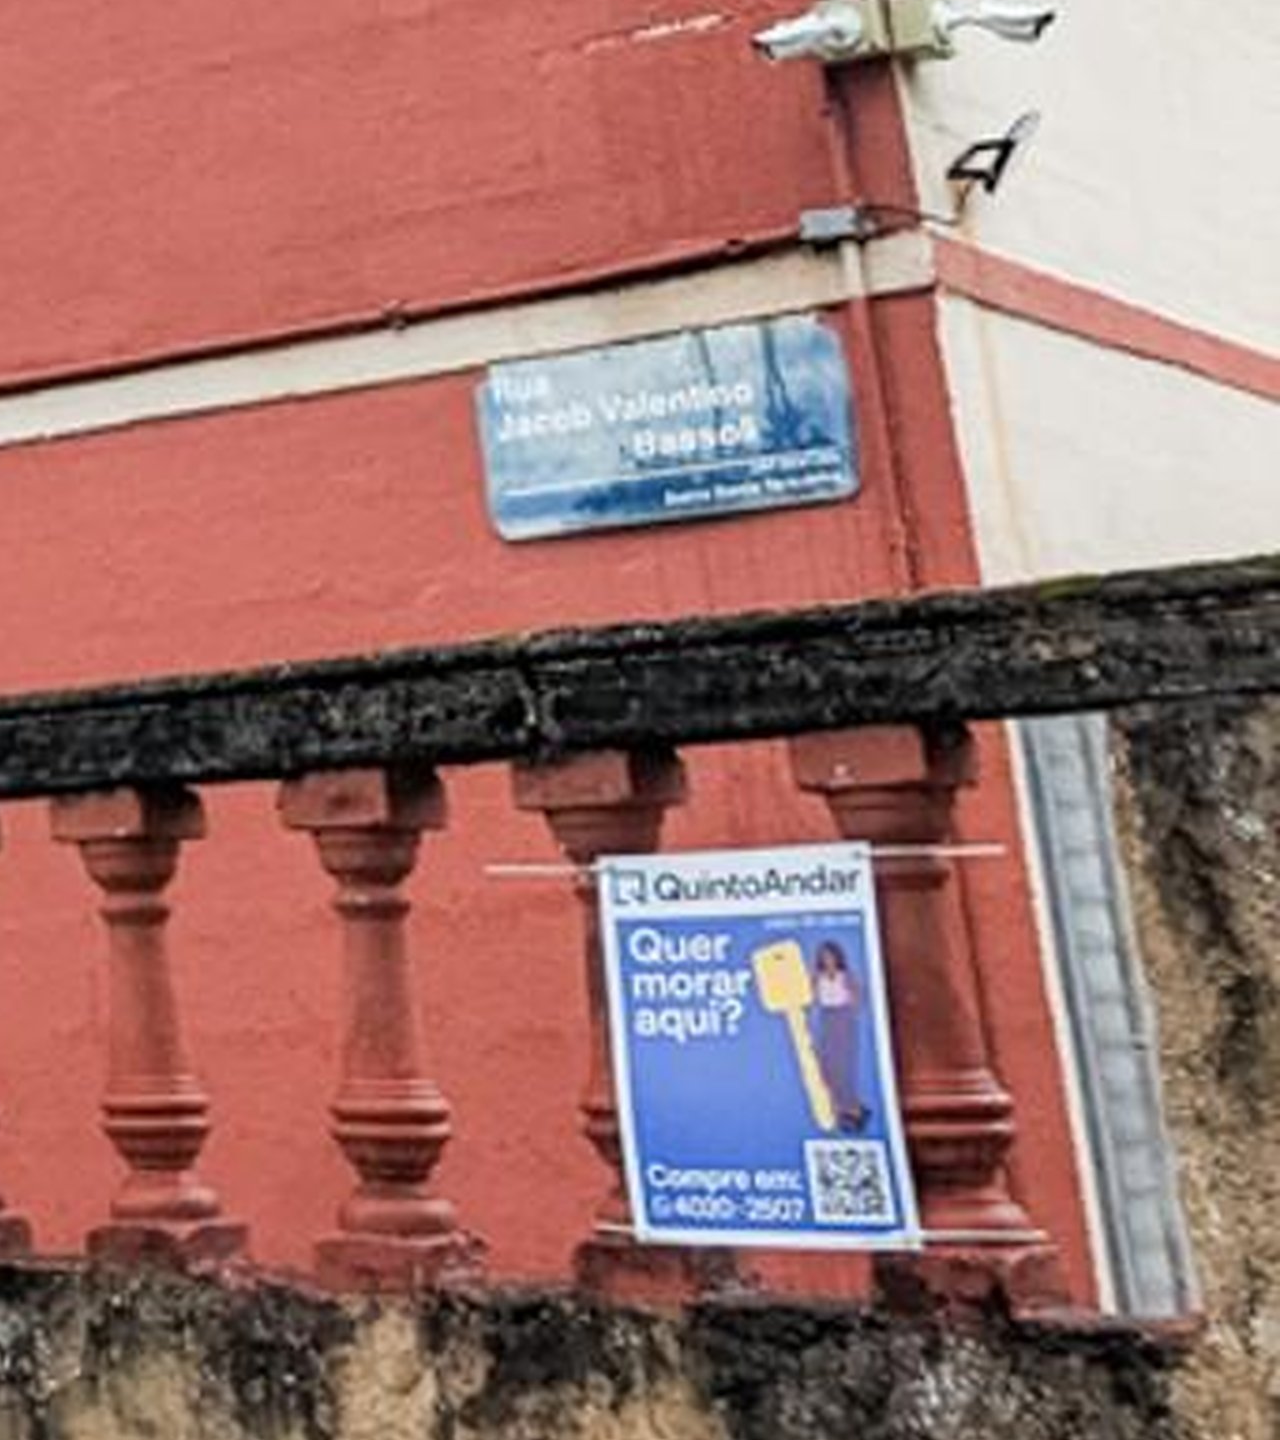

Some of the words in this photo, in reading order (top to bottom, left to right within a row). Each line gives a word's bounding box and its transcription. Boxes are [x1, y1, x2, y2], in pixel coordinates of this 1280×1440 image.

[493, 375, 550, 404] Rua
[498, 399, 592, 443] Jacob
[596, 382, 754, 422] Valentino
[653, 864, 861, 902] QuintoAndar
[629, 927, 733, 964] Quer
[633, 969, 752, 1000] morar
[635, 998, 744, 1043] aqui?
[648, 1163, 752, 1193] Compre
